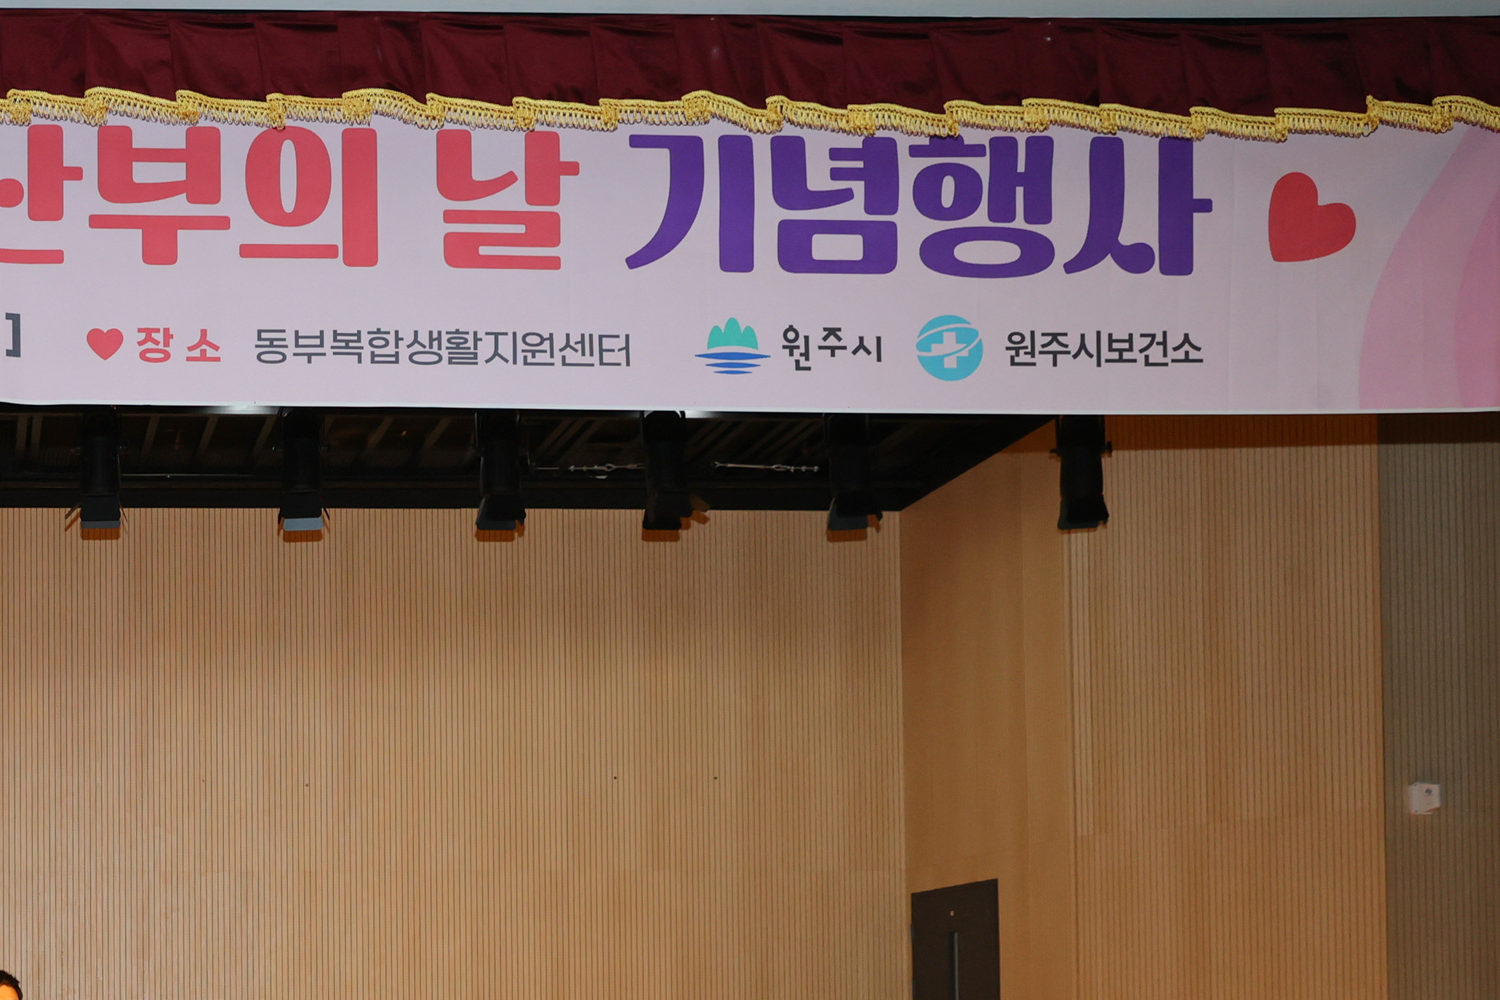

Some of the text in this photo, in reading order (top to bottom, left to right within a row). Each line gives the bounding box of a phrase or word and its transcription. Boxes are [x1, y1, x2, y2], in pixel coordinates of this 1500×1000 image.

[436, 130, 580, 271] 날
[625, 134, 1214, 279] 기념행사
[255, 328, 631, 367] 동부복합생활지원센터
[782, 325, 882, 371] 원주시
[1005, 330, 1203, 367] 원주시보건소
